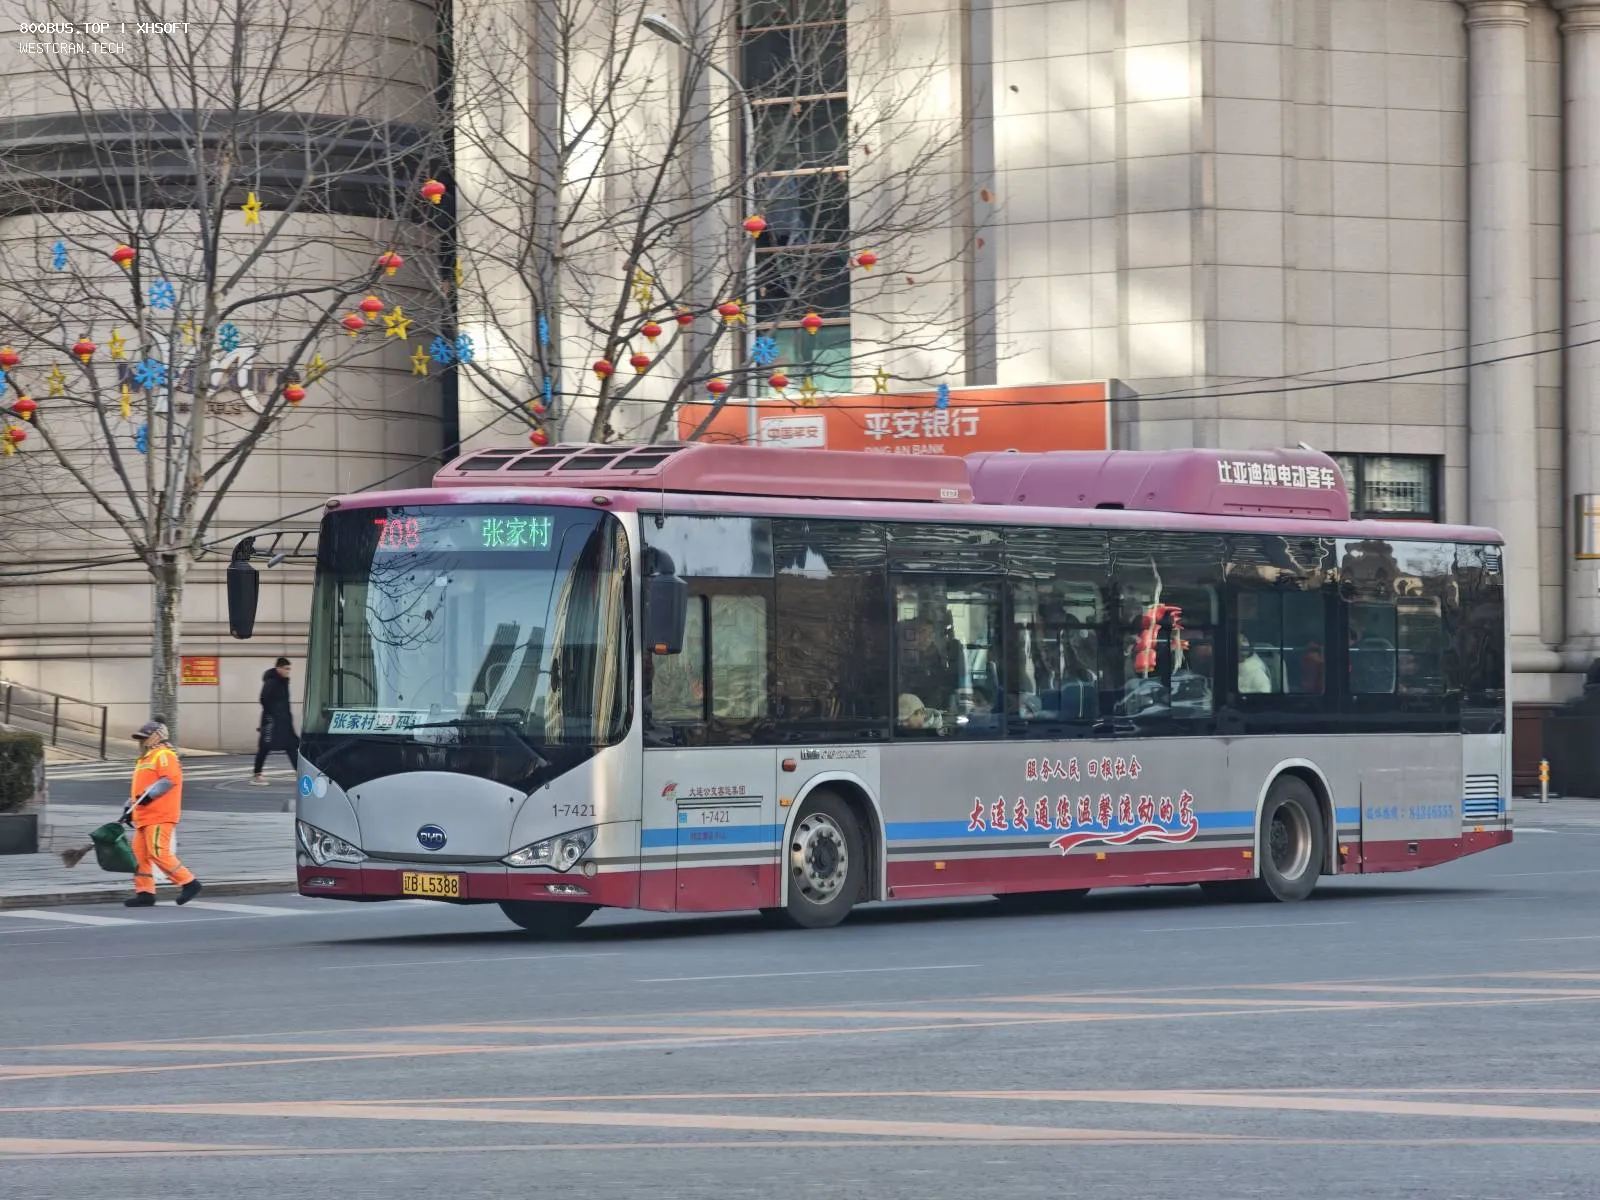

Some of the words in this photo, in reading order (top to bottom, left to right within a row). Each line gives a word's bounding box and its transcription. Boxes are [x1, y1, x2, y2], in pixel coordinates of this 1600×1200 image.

[864, 408, 980, 440] 平安银行
[1217, 460, 1336, 489] 比亚迪纯电动客车
[374, 517, 417, 549] 708
[483, 516, 551, 547] 张家村
[333, 713, 375, 729] 张家村
[1027, 757, 1080, 782] 服务人民
[1088, 754, 1142, 781] 回报社会
[552, 804, 597, 817] 1-7421
[701, 810, 730, 825] 1-7421
